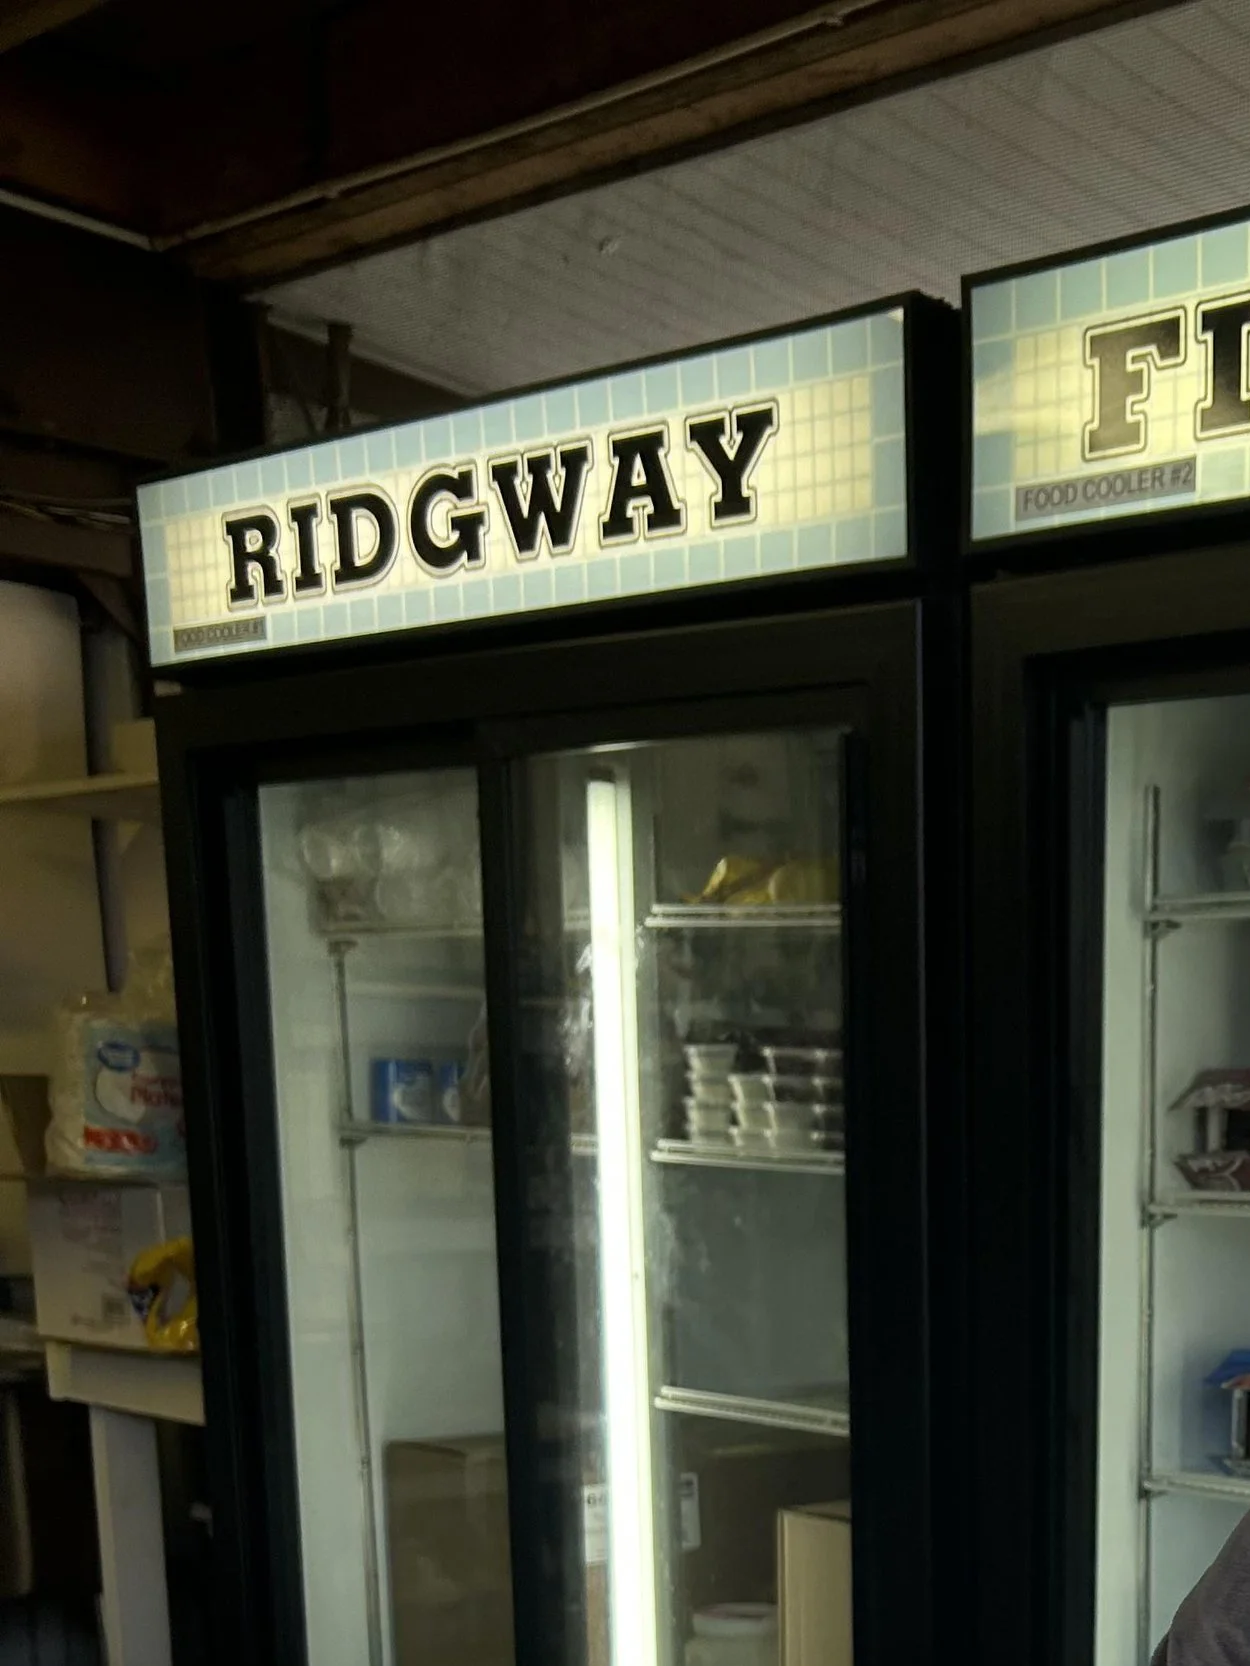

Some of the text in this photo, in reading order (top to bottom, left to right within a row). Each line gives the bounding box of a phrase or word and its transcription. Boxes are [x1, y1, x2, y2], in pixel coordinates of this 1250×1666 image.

[221, 398, 779, 611] RIDGWAY
[1022, 461, 1193, 513] FOOD COOLER #2
